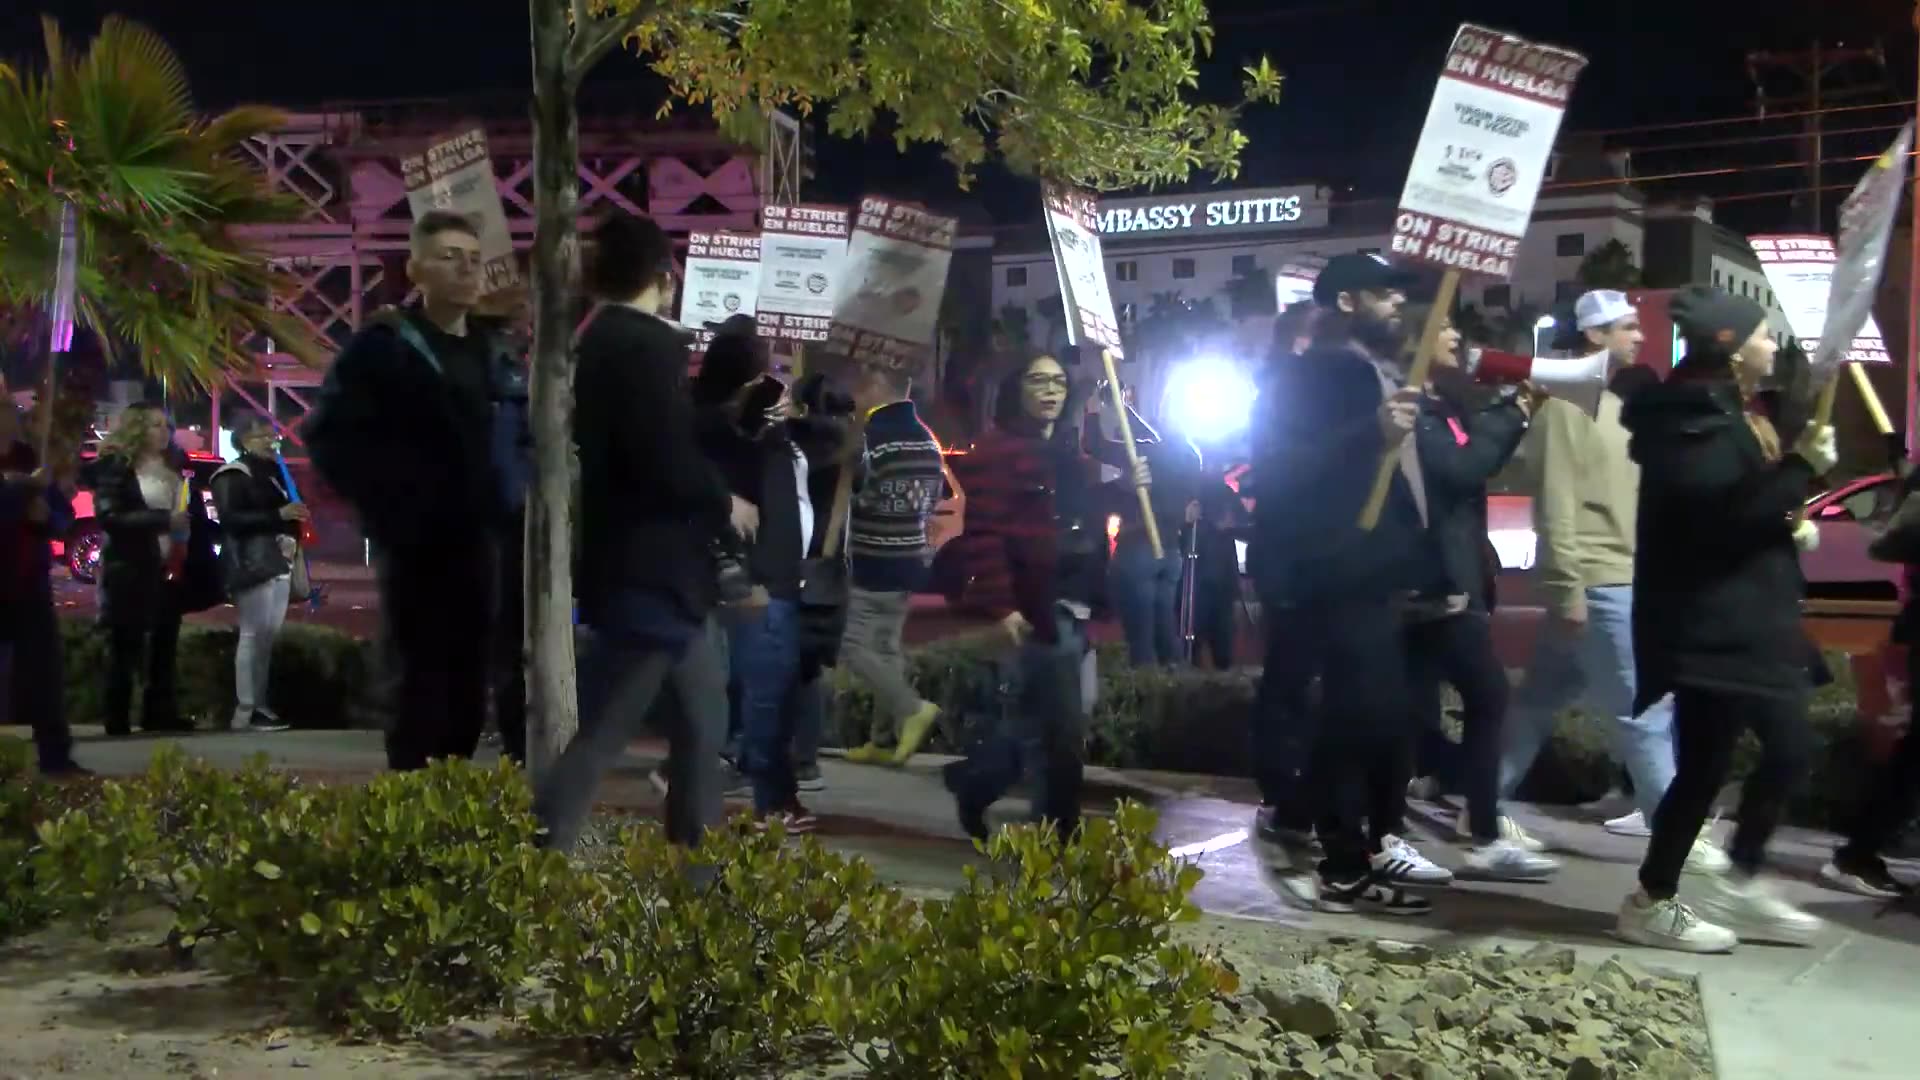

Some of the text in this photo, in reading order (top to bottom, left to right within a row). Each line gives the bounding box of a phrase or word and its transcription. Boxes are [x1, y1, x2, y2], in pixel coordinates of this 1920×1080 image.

[1456, 33, 1583, 81] ON STRIKE
[1447, 54, 1568, 100] EN HUELGA
[764, 206, 848, 222] ON STRIKE
[861, 198, 889, 215] ON
[1097, 204, 1196, 233] MBASSY
[1206, 195, 1301, 226] SUITES
[763, 218, 847, 235] EN HUELGA
[857, 213, 882, 229] EN
[690, 232, 761, 248] ON STRIKE
[1396, 213, 1519, 257] ON STRIKE
[688, 245, 760, 258] EN HUELGA
[1750, 239, 1836, 250] ON STRIKE
[1392, 234, 1510, 276] EN HUELGA
[757, 313, 780, 326] ON
[757, 328, 777, 337] EN
